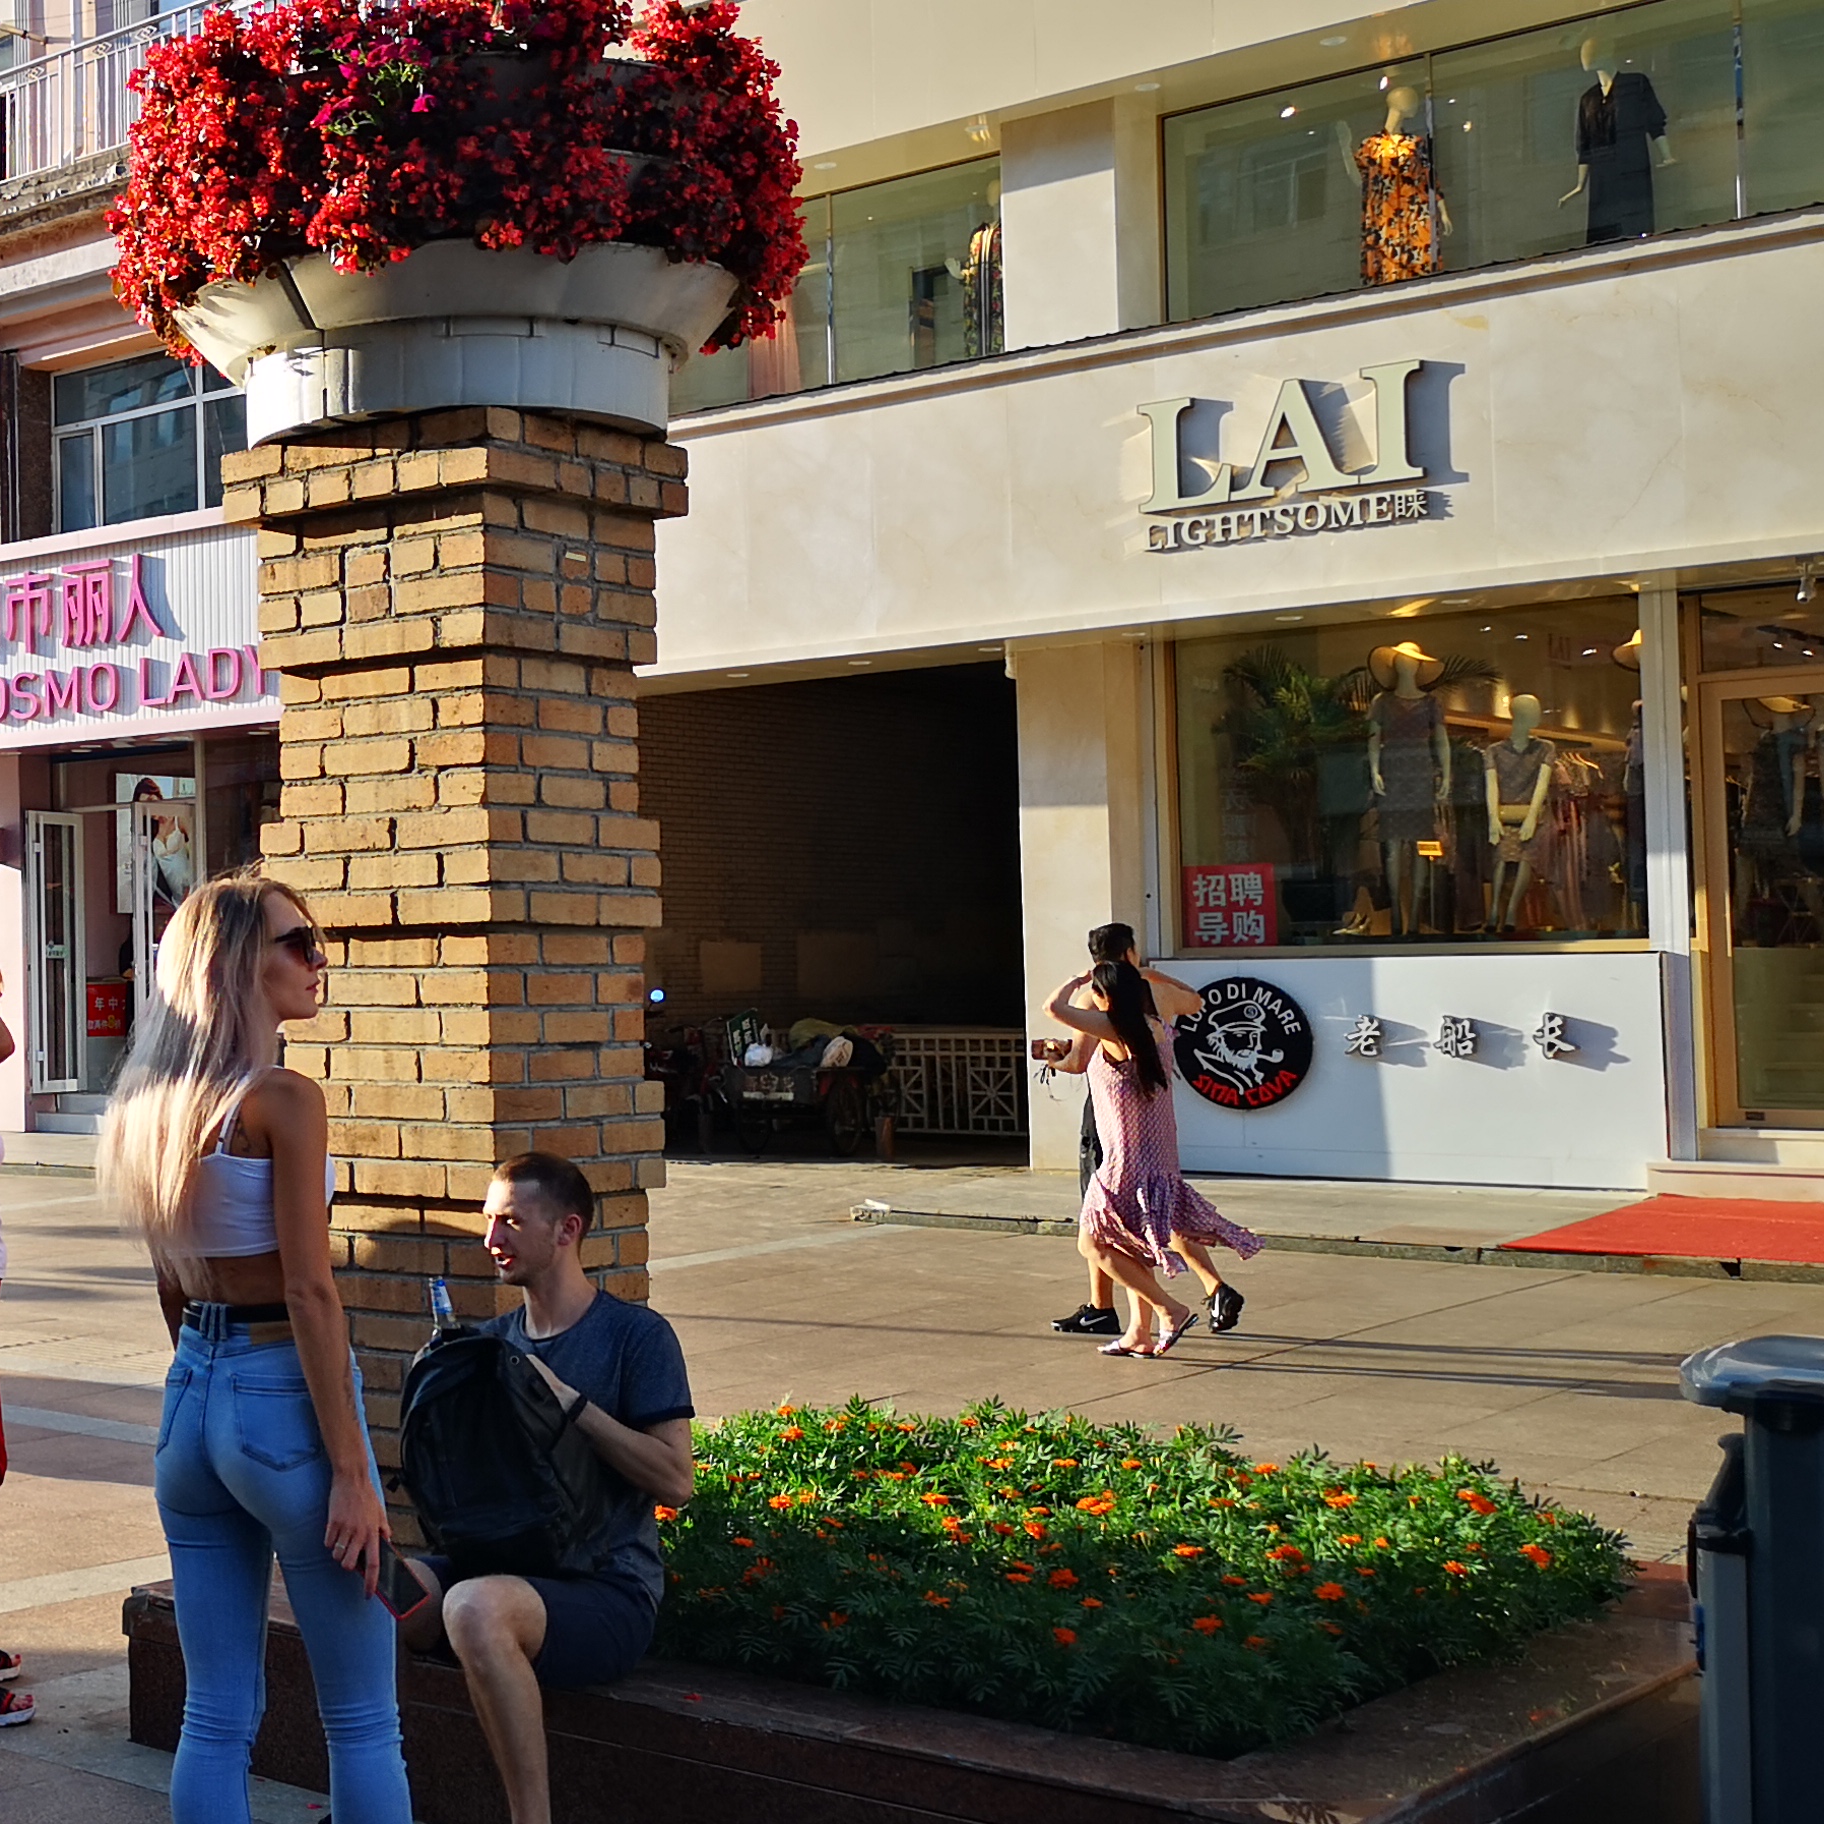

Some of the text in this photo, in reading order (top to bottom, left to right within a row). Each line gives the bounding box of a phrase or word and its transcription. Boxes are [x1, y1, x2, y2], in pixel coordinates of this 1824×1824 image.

[1137, 359, 1424, 514] LAI
[1145, 493, 1391, 551] LIGHTSOME
[1193, 872, 1265, 908] 招聘
[1194, 909, 1266, 945] 导购
[1227, 983, 1246, 999] DI
[1253, 986, 1302, 1035] MARE
[1344, 1011, 1577, 1059] 老船长
